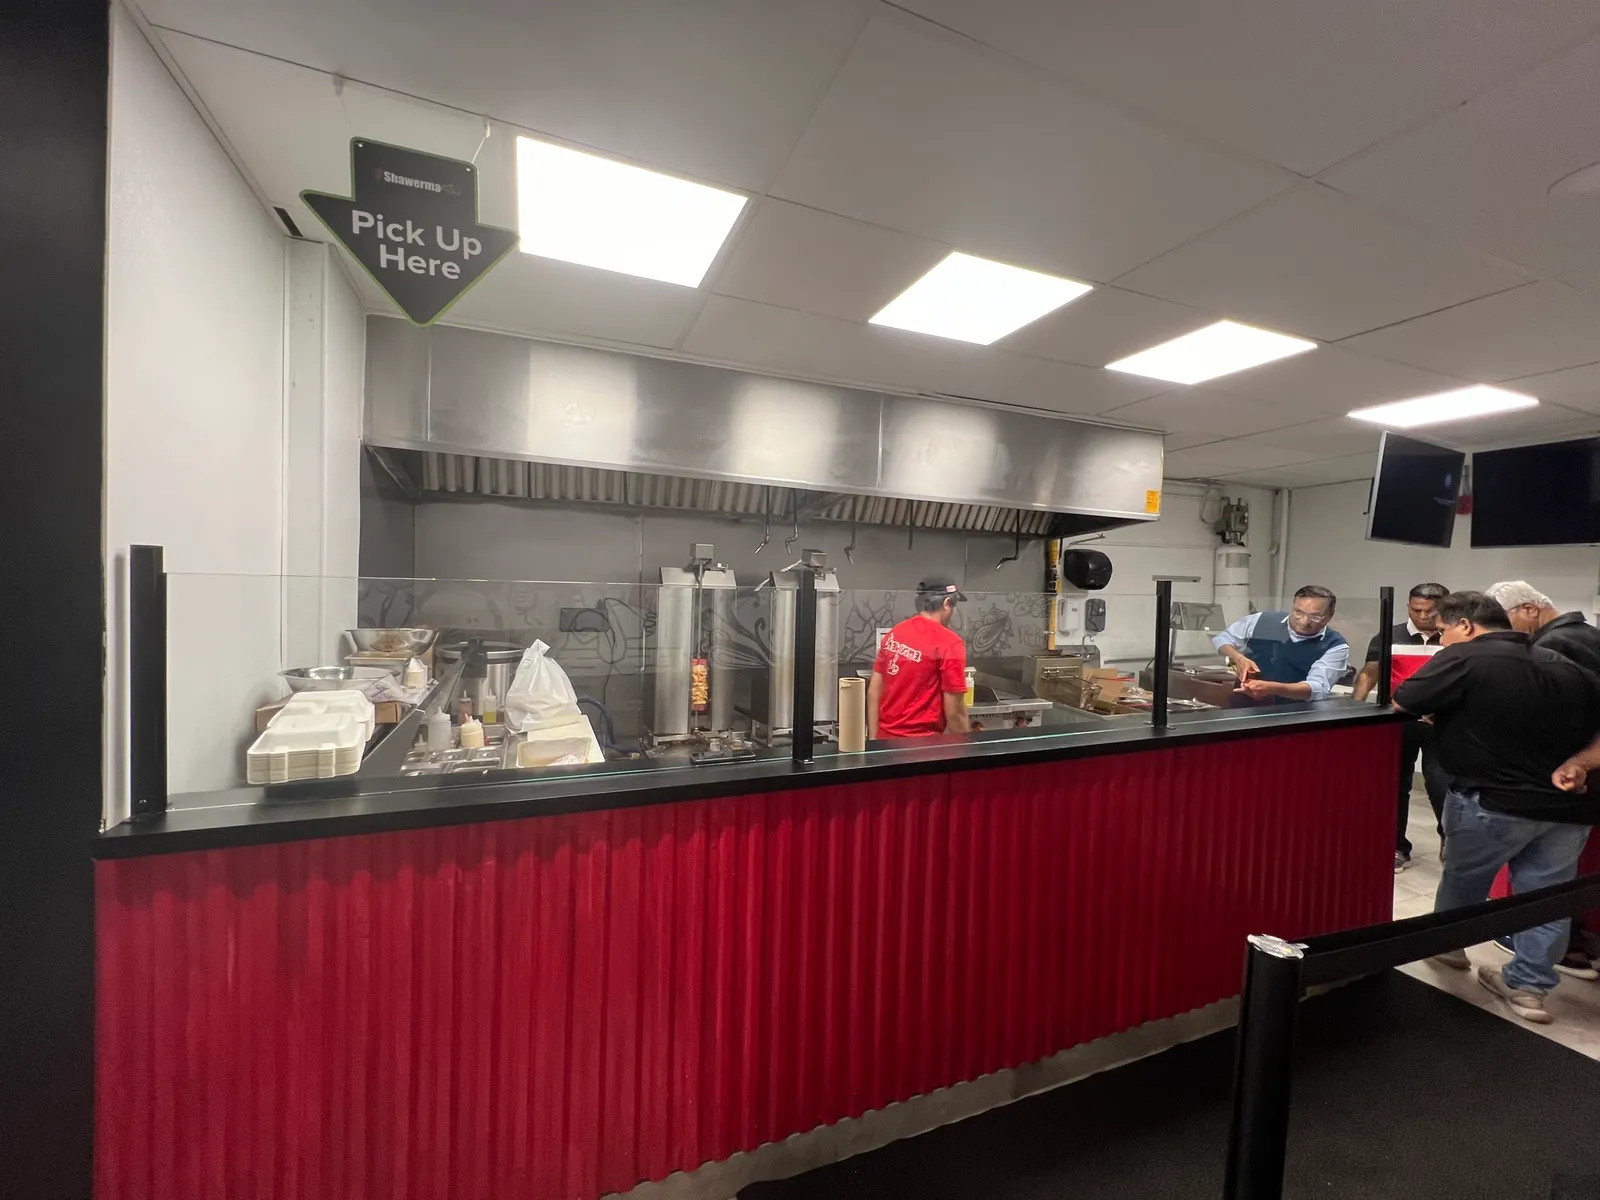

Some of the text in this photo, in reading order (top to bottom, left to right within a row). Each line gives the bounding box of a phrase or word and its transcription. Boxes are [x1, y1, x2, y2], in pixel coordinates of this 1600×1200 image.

[384, 171, 441, 193] Shawerma
[352, 210, 482, 259] Pick Up
[379, 244, 460, 279] Here
